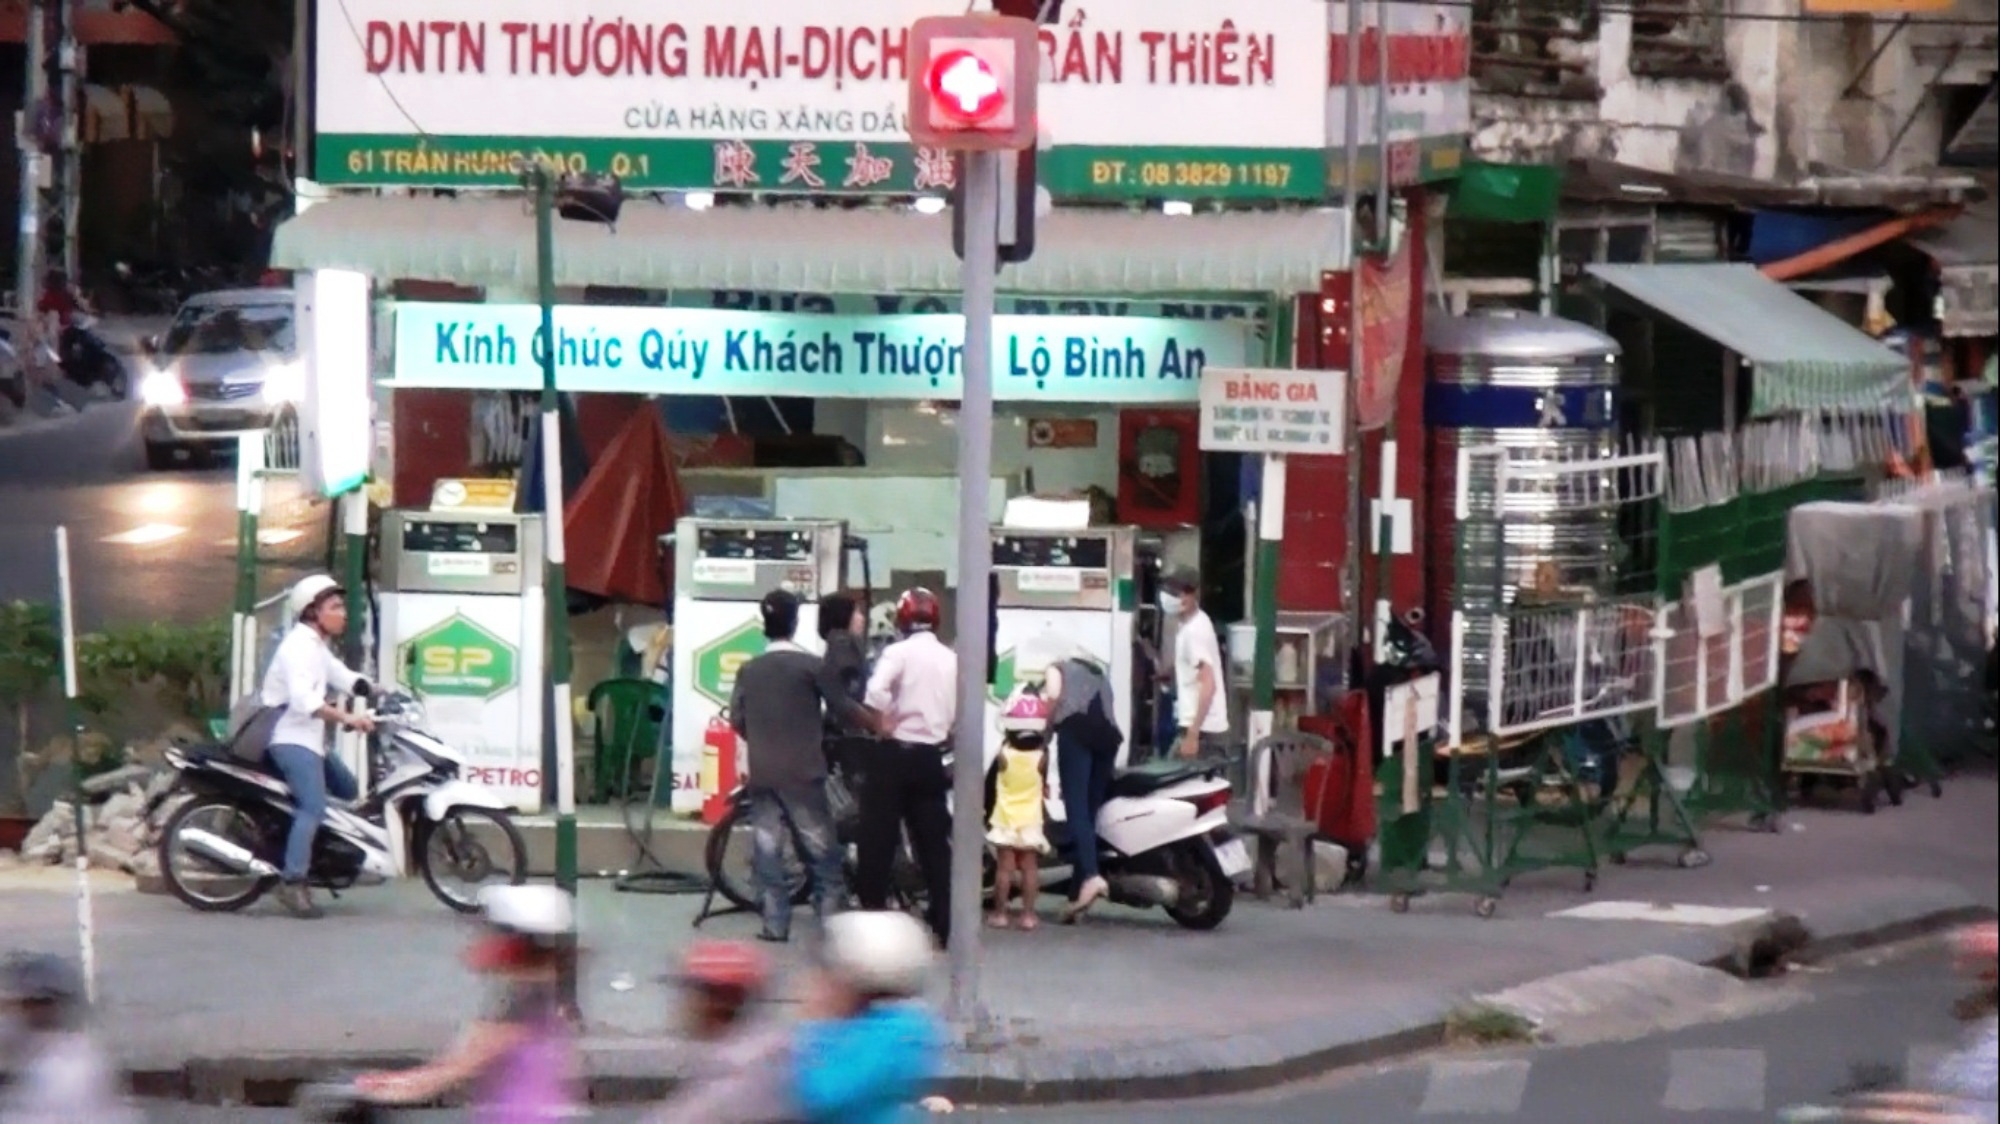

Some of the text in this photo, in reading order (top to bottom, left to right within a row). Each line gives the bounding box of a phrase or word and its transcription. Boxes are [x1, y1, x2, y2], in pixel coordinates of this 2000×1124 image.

[367, 21, 485, 75] DNTN
[501, 16, 688, 77] THƯƠNG
[704, 26, 908, 91] MẠI-DỊCH
[1037, 8, 1122, 84] RẦN
[1139, 19, 1274, 86] THIÊN
[622, 99, 681, 131] CỬA
[689, 102, 768, 132] HÀNG
[776, 104, 854, 134] XĂNG
[348, 148, 374, 174] 61
[611, 151, 650, 178] Q.1
[1141, 161, 1170, 187] 08
[1174, 162, 1232, 187] 3829
[1237, 163, 1292, 188] 1197
[435, 322, 1206, 390] Kính Chúc Qúy Khách Thượn Lộ Bình An
[422, 644, 494, 675] SP
[466, 766, 543, 789] PETRO
[670, 771, 701, 791] SAI
